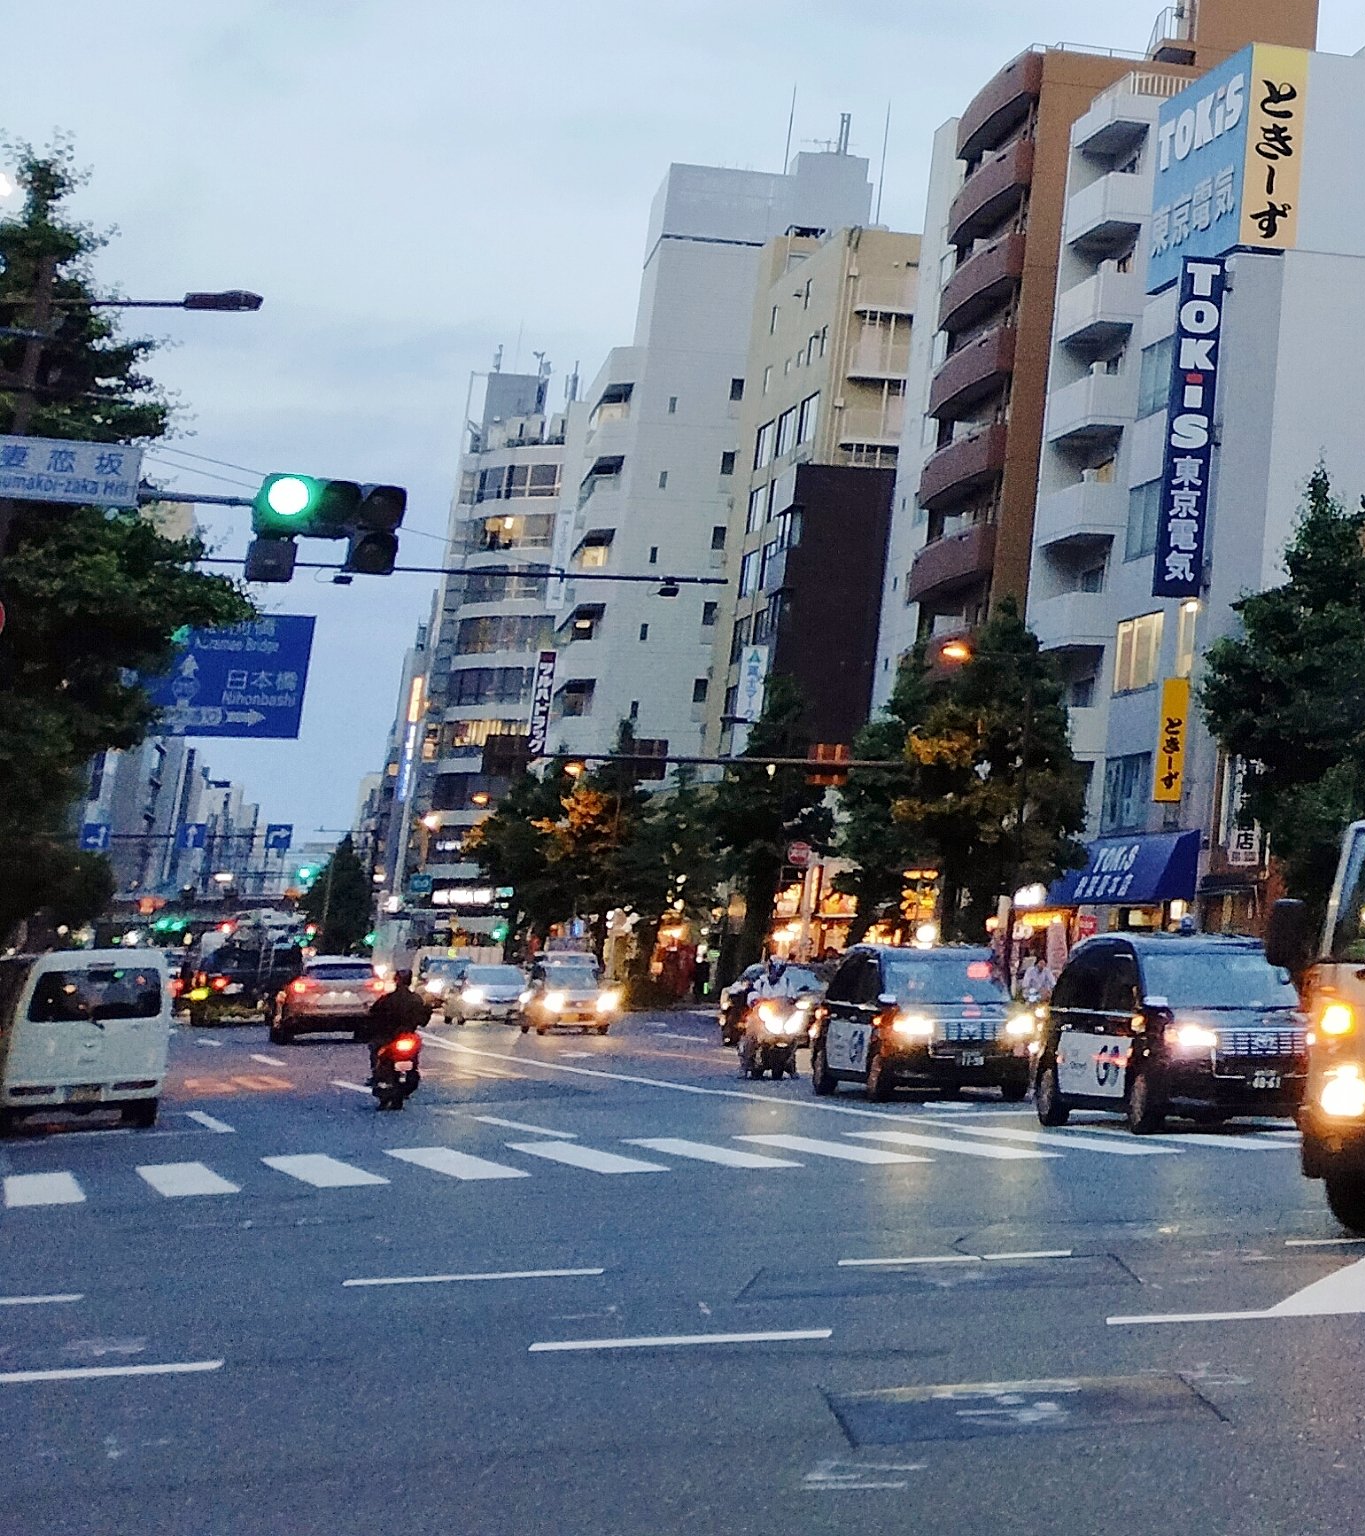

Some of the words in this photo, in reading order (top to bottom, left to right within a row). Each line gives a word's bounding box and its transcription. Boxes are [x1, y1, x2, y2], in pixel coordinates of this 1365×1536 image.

[1158, 73, 1245, 172] TOKiS
[1249, 79, 1297, 240] ときーず
[1151, 164, 1236, 259] 東京電気
[1170, 262, 1221, 449] TOKiS
[1164, 455, 1204, 582] 東京電気
[222, 690, 296, 708] Nihonbashi
[227, 669, 298, 691] 日本橋
